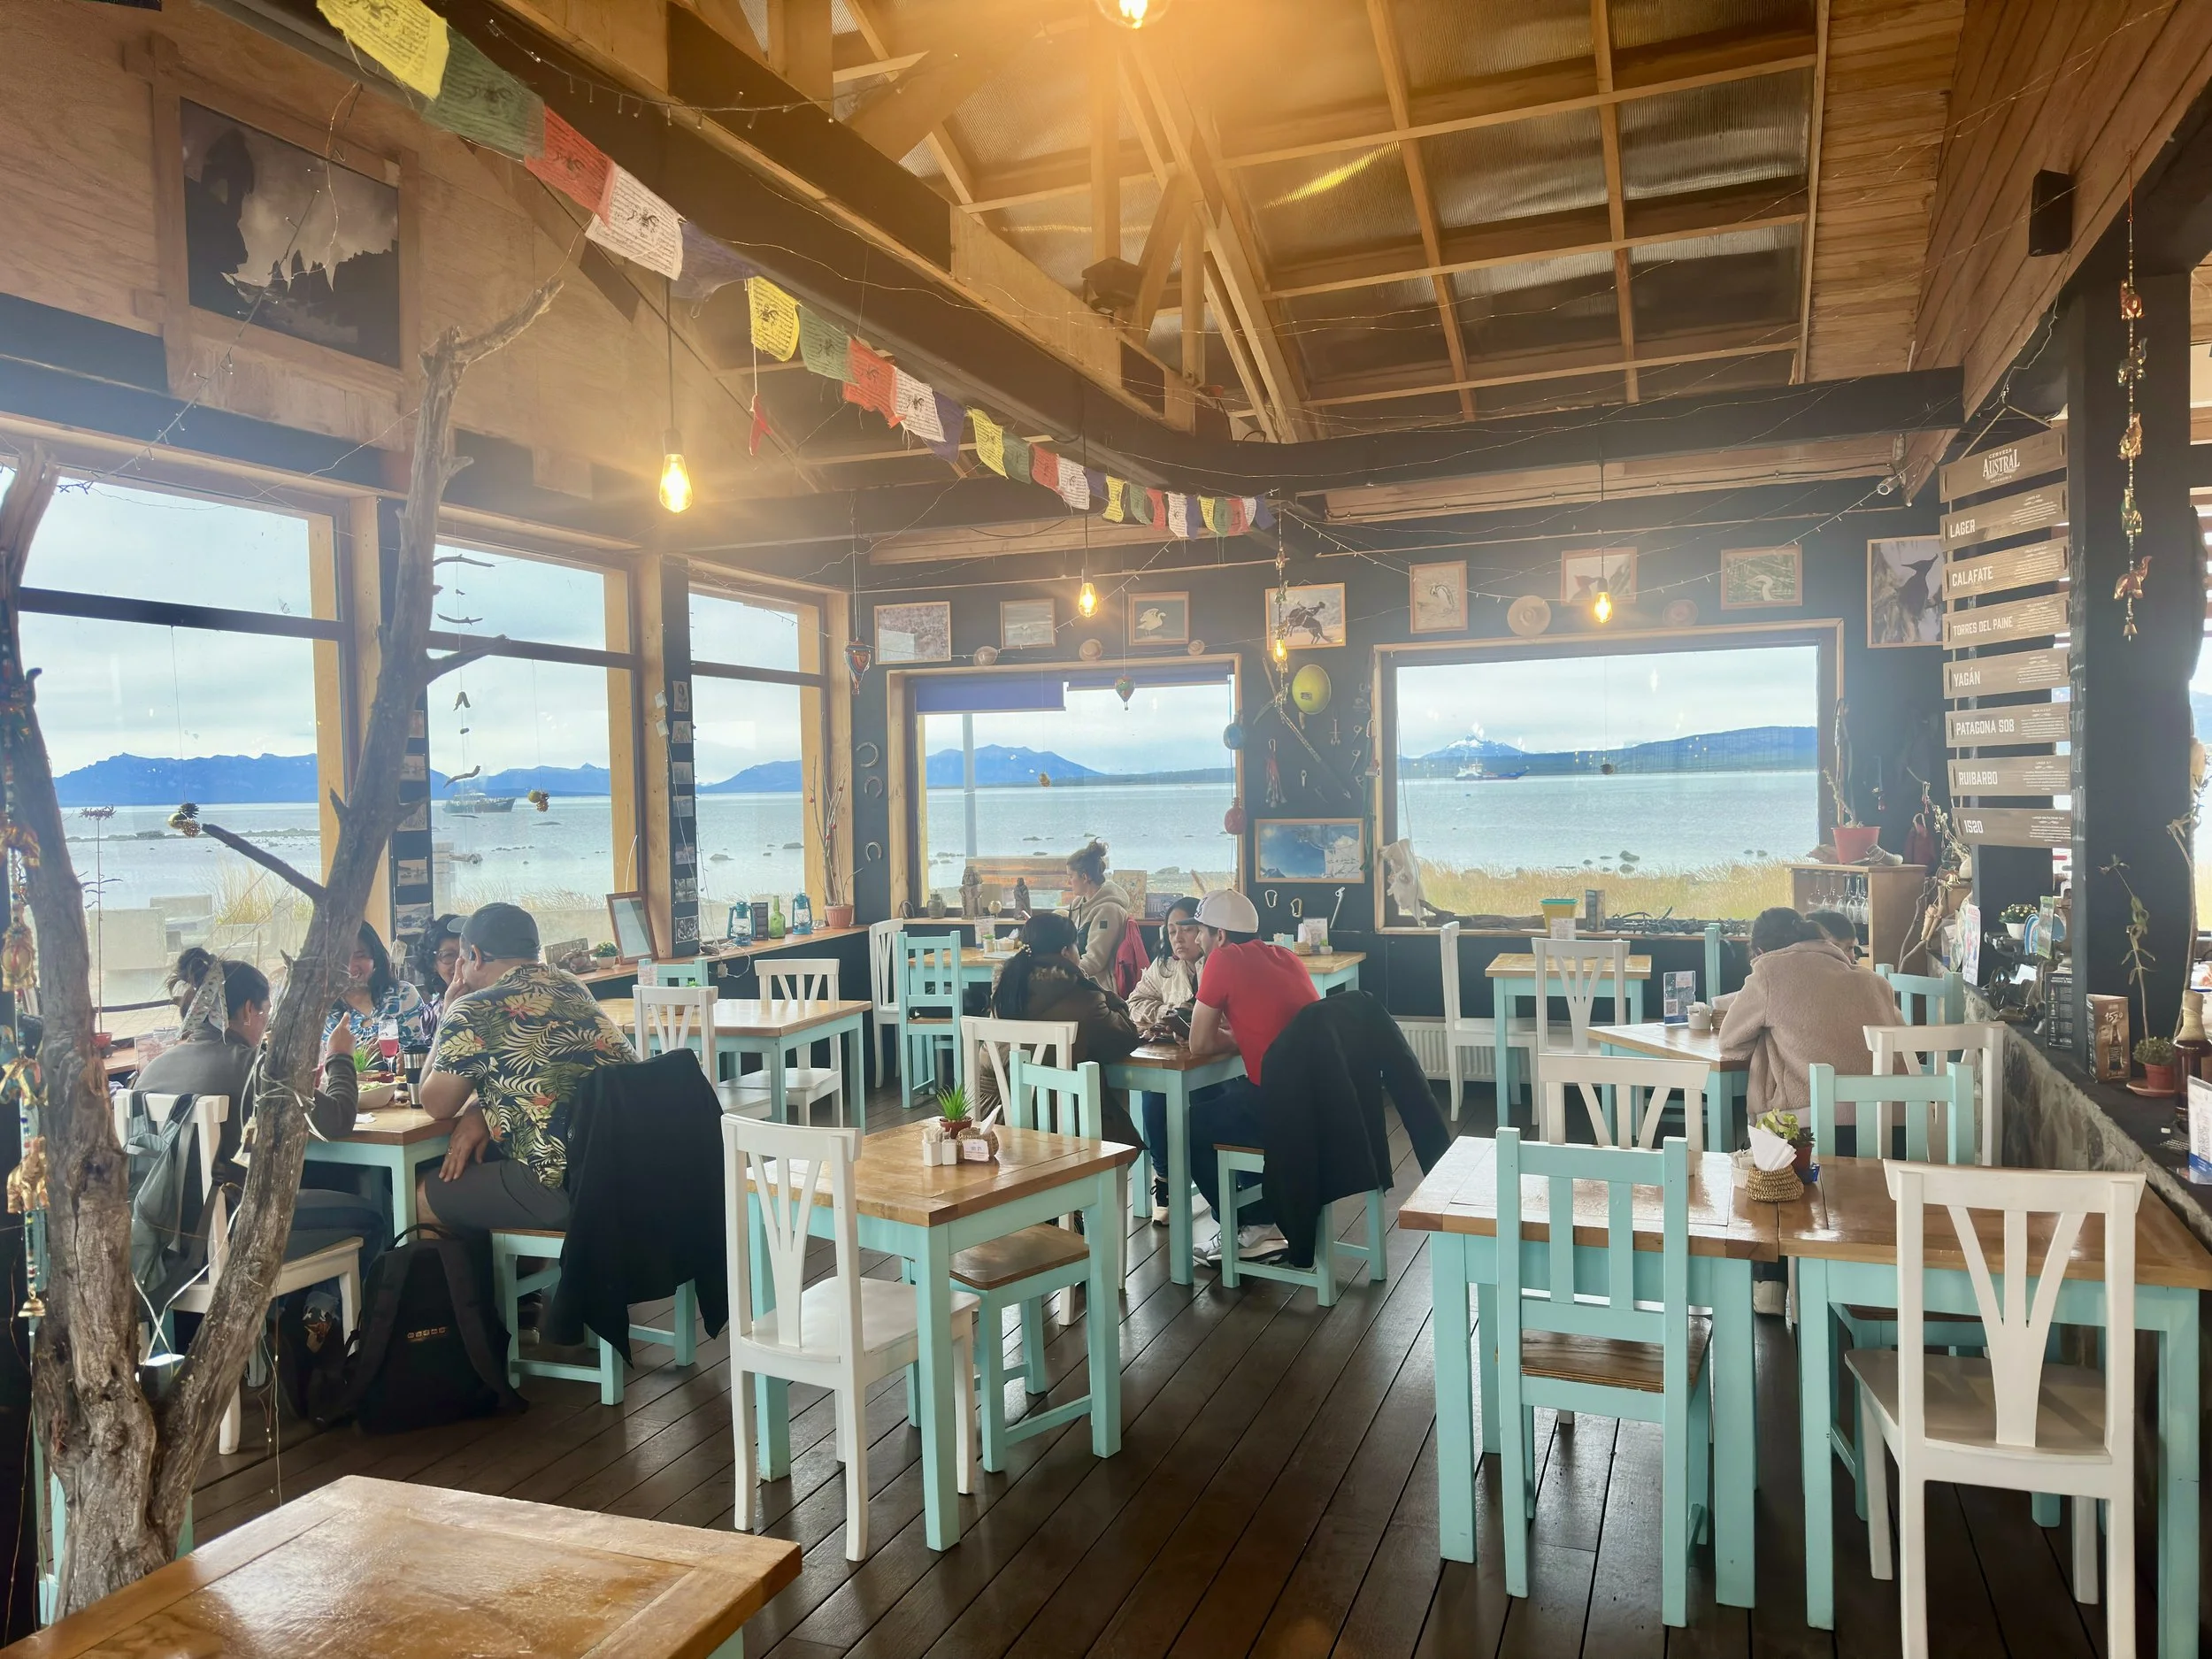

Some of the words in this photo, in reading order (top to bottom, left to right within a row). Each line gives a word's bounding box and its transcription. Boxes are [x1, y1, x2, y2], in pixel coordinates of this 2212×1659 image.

[1982, 449, 2020, 478] AUSTRAL
[1949, 518, 1976, 538] LAGER
[1952, 565, 1993, 587] CALAFATE
[1953, 622, 1978, 636] TORRES
[1978, 619, 1991, 632] DEL
[1993, 616, 2013, 630] PAINE
[1954, 667, 1981, 687] YAGÁN
[1956, 720, 1996, 735] PATAGONA
[1958, 772, 1998, 786] RUIBARBO
